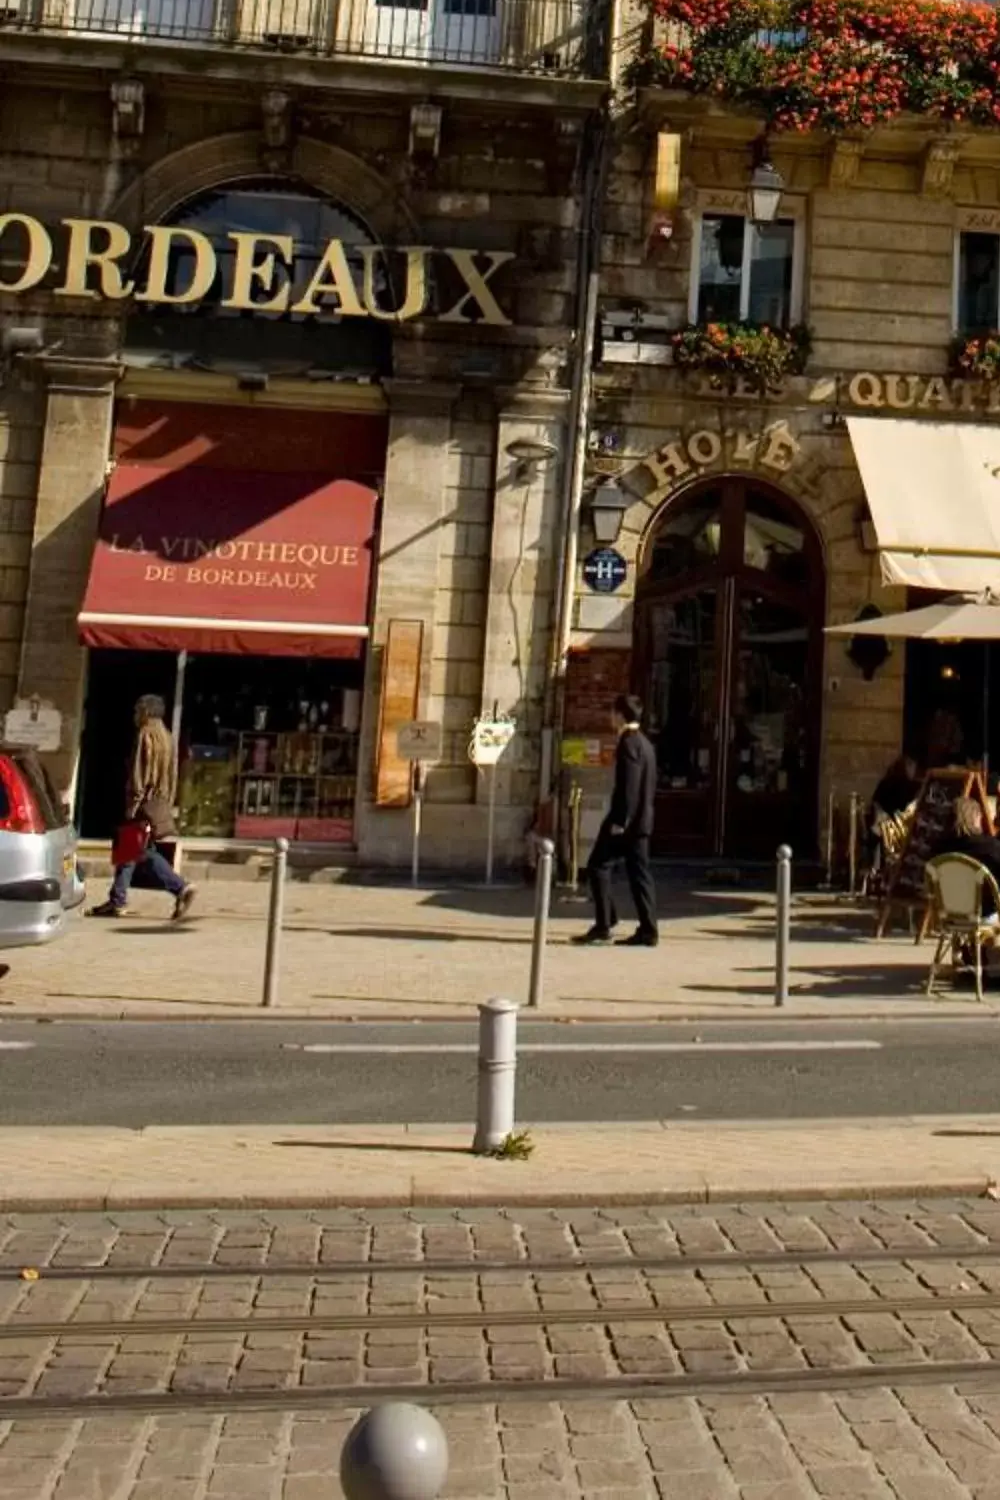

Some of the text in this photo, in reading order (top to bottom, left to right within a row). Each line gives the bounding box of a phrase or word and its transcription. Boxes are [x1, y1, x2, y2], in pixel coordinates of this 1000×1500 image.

[110, 531, 359, 568] LA VINOTHEQUE
[144, 564, 319, 591] DE BORDEAUX
